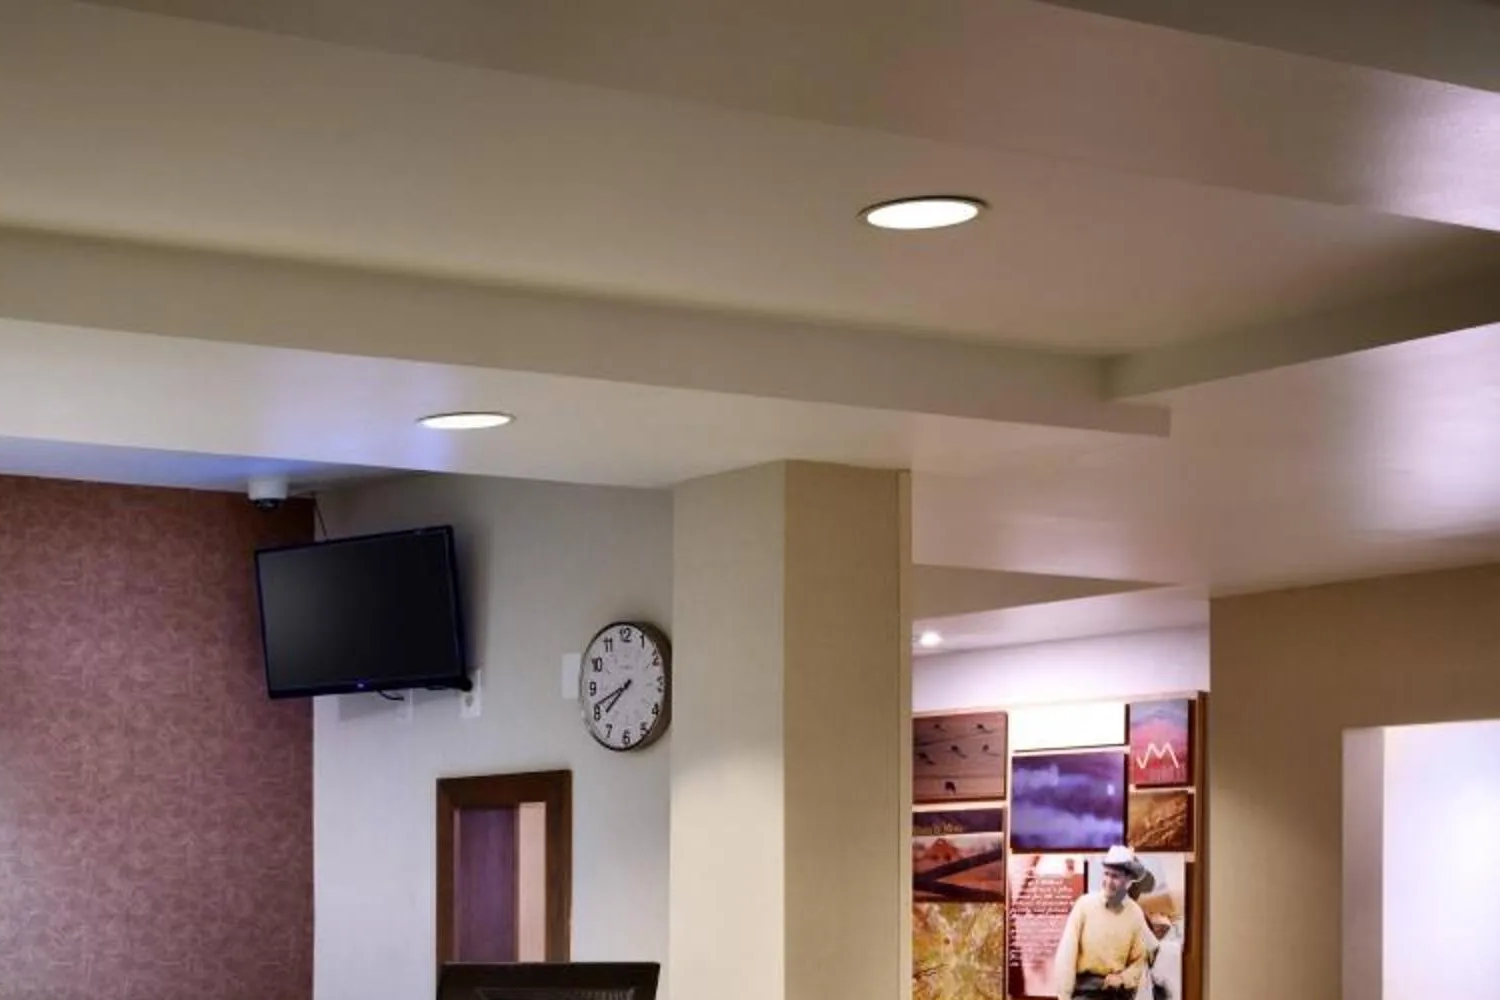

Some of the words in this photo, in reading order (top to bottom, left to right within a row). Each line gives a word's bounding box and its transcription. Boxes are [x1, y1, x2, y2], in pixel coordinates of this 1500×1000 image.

[619, 627, 631, 642] 12
[604, 636, 613, 652] 11
[591, 657, 603, 672] 10
[589, 681, 596, 696] 9
[594, 704, 601, 721] 8
[652, 703, 659, 716] 4
[606, 724, 613, 739] 7
[622, 730, 630, 745] 6
